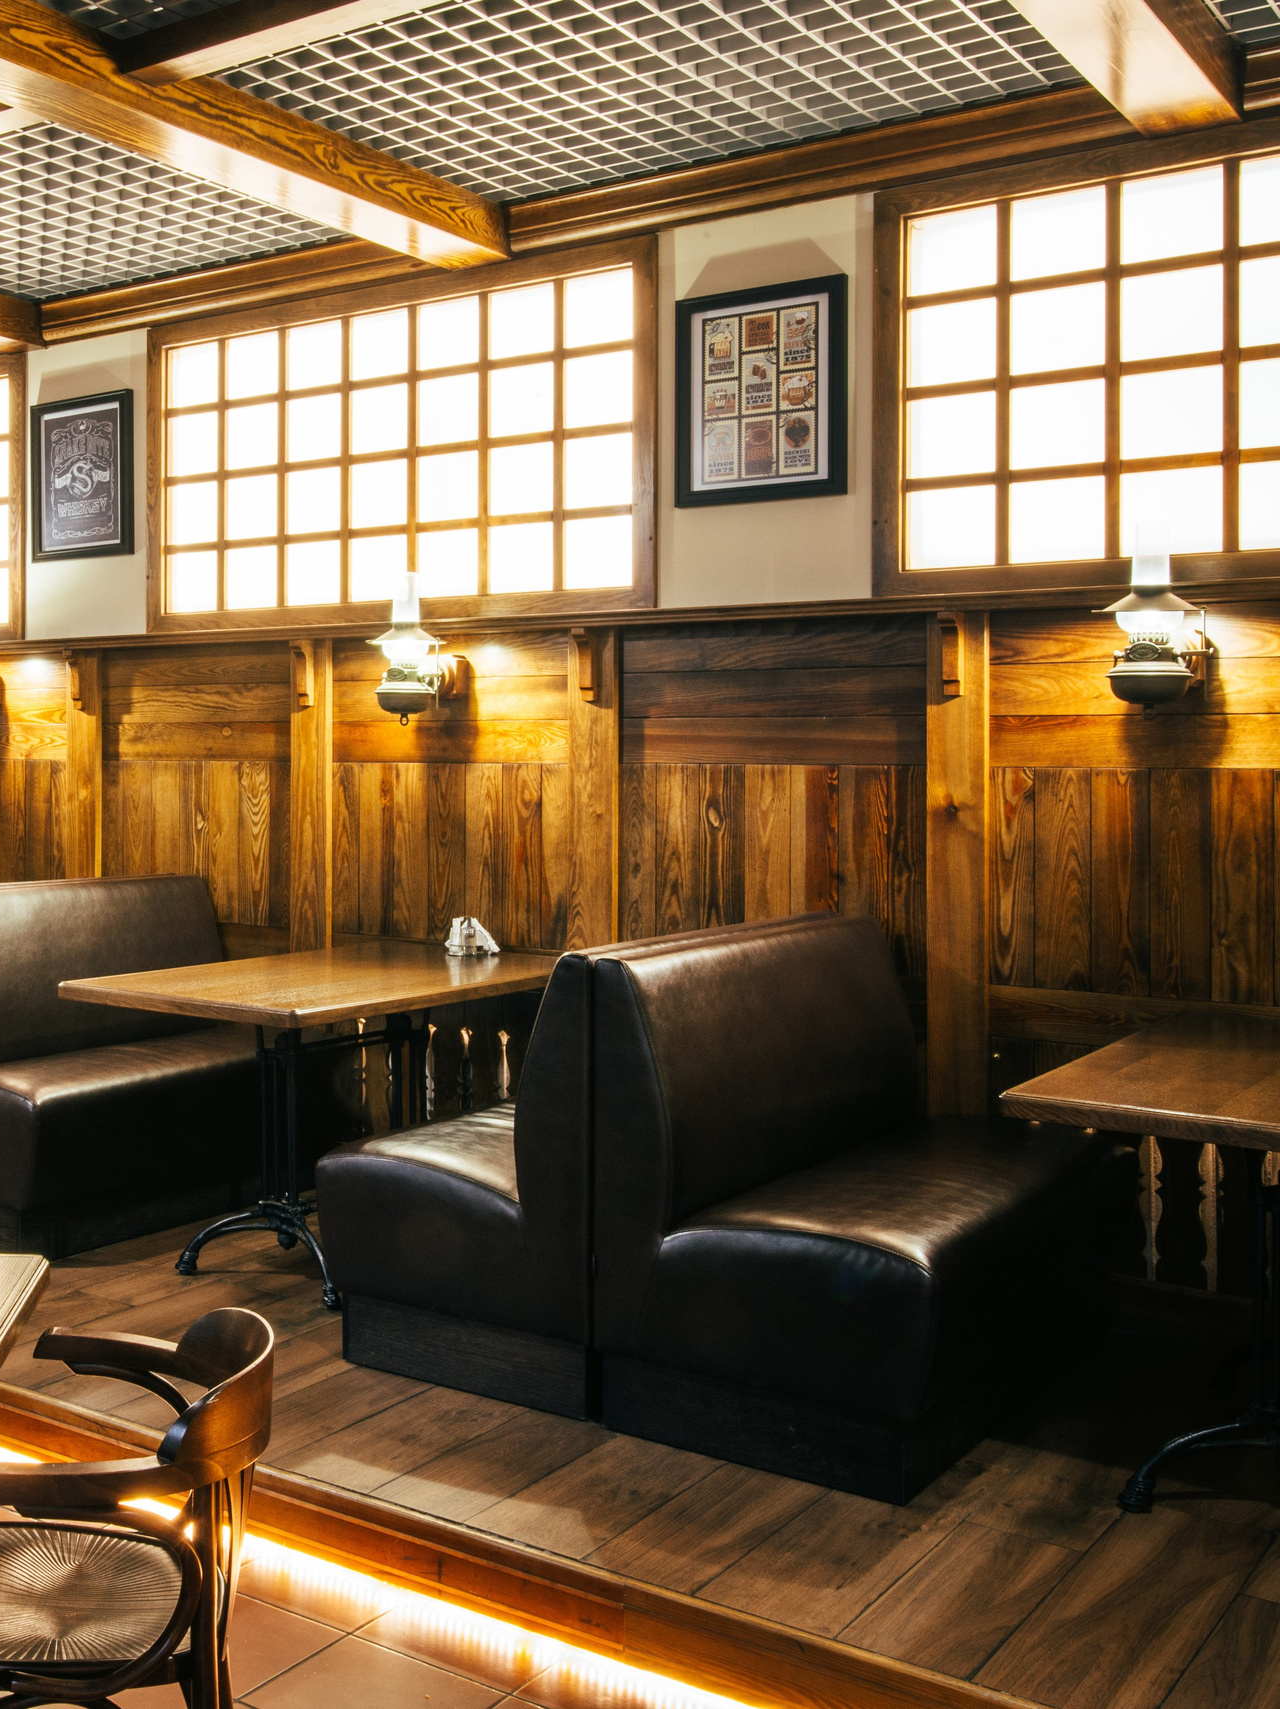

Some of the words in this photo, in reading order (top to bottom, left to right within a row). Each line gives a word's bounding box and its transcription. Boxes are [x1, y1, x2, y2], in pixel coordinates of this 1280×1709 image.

[784, 348, 812, 356] since
[54, 435, 86, 468] SNAKE
[87, 434, 110, 460] BITE
[708, 466, 735, 474] 1875
[57, 498, 109, 518] WHISKEY
